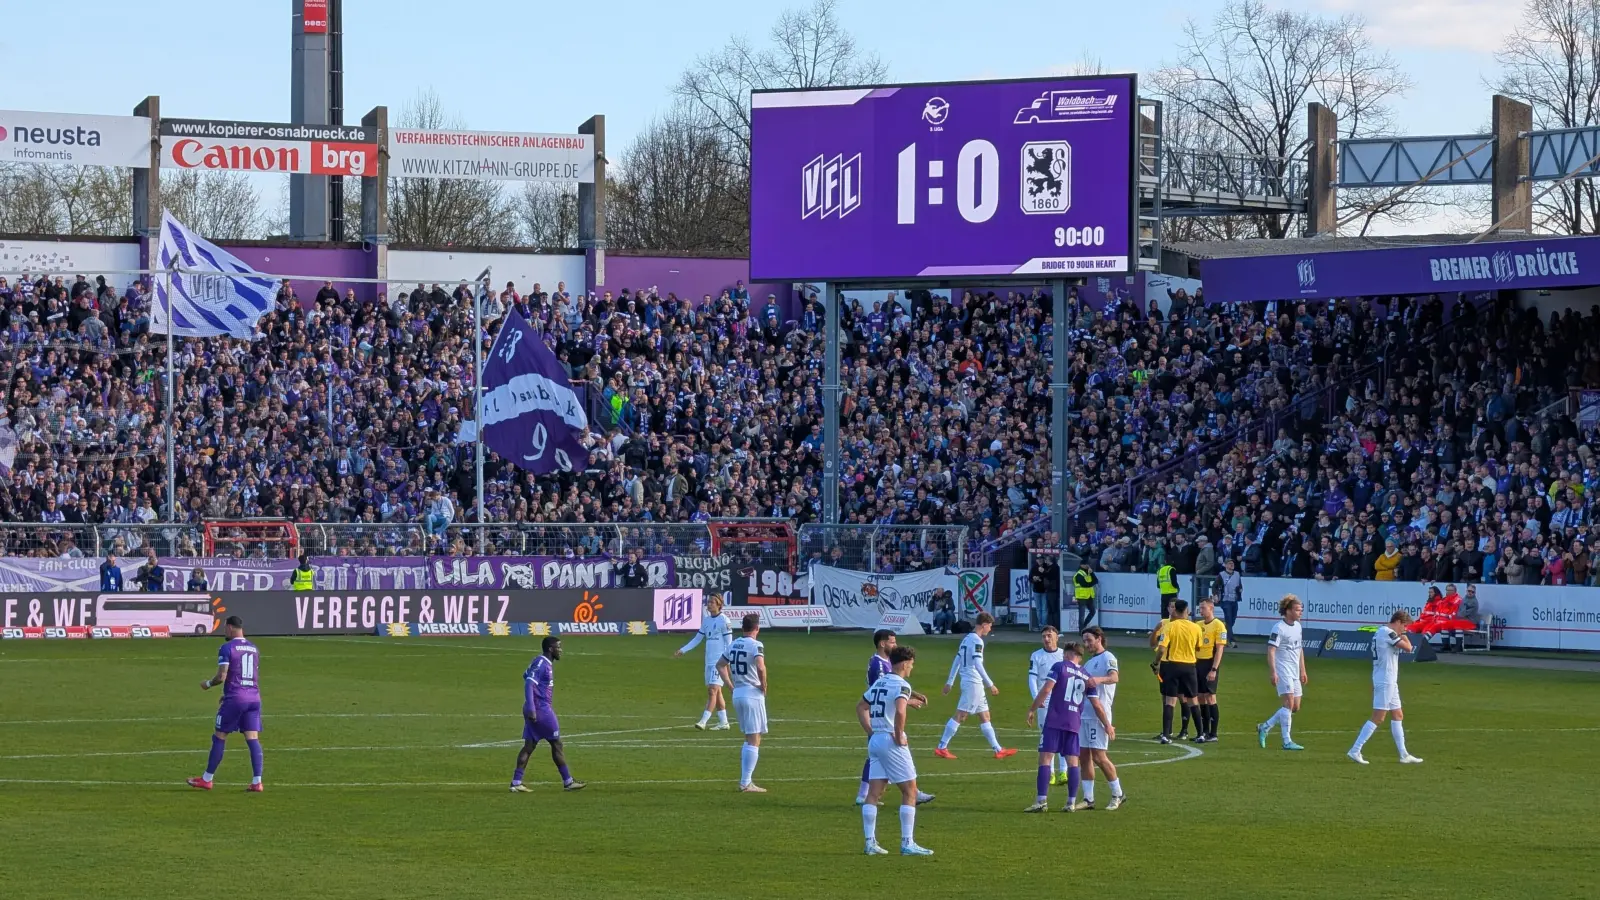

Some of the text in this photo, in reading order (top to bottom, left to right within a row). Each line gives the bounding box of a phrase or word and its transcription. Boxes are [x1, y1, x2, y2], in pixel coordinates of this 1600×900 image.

[1057, 96, 1095, 106] Waldbach
[14, 124, 101, 147] neusta
[172, 121, 365, 142] www.kopierer-osnabrueck.de
[395, 131, 585, 151] VERFAHRENSTECHNISCHER ANLAGENBAU
[14, 147, 73, 161] infomantis
[172, 139, 299, 171] Canon
[322, 144, 366, 175] brg
[402, 156, 579, 179] WWW.KITZMANN-GRUPPE.DE
[1031, 198, 1060, 209] 1860
[1054, 226, 1105, 247] 90:00
[1041, 259, 1117, 270] BRIDGE TO YOUR HEART
[1430, 256, 1492, 282] BREMER
[1515, 246, 1579, 277] BRÜCKE
[39, 559, 97, 572] FAN-CLUB
[187, 558, 214, 566] EIMER
[219, 558, 231, 566] IST
[433, 559, 668, 588] LILA PANTR
[676, 568, 732, 591] BOYS
[823, 583, 861, 609] OSNA
[1102, 592, 1146, 608] der Region
[295, 596, 510, 629] VEREGGE & WELZ
[773, 609, 824, 617] ASSMANN
[1308, 599, 1354, 614] brauchen
[1357, 602, 1374, 615] den
[418, 622, 480, 634] MERKUR
[559, 622, 619, 634] MERKUR
[1492, 615, 1507, 628] the
[241, 652, 254, 679] 11
[729, 650, 748, 675] 26
[1063, 675, 1086, 705] 18
[869, 688, 889, 718] 25
